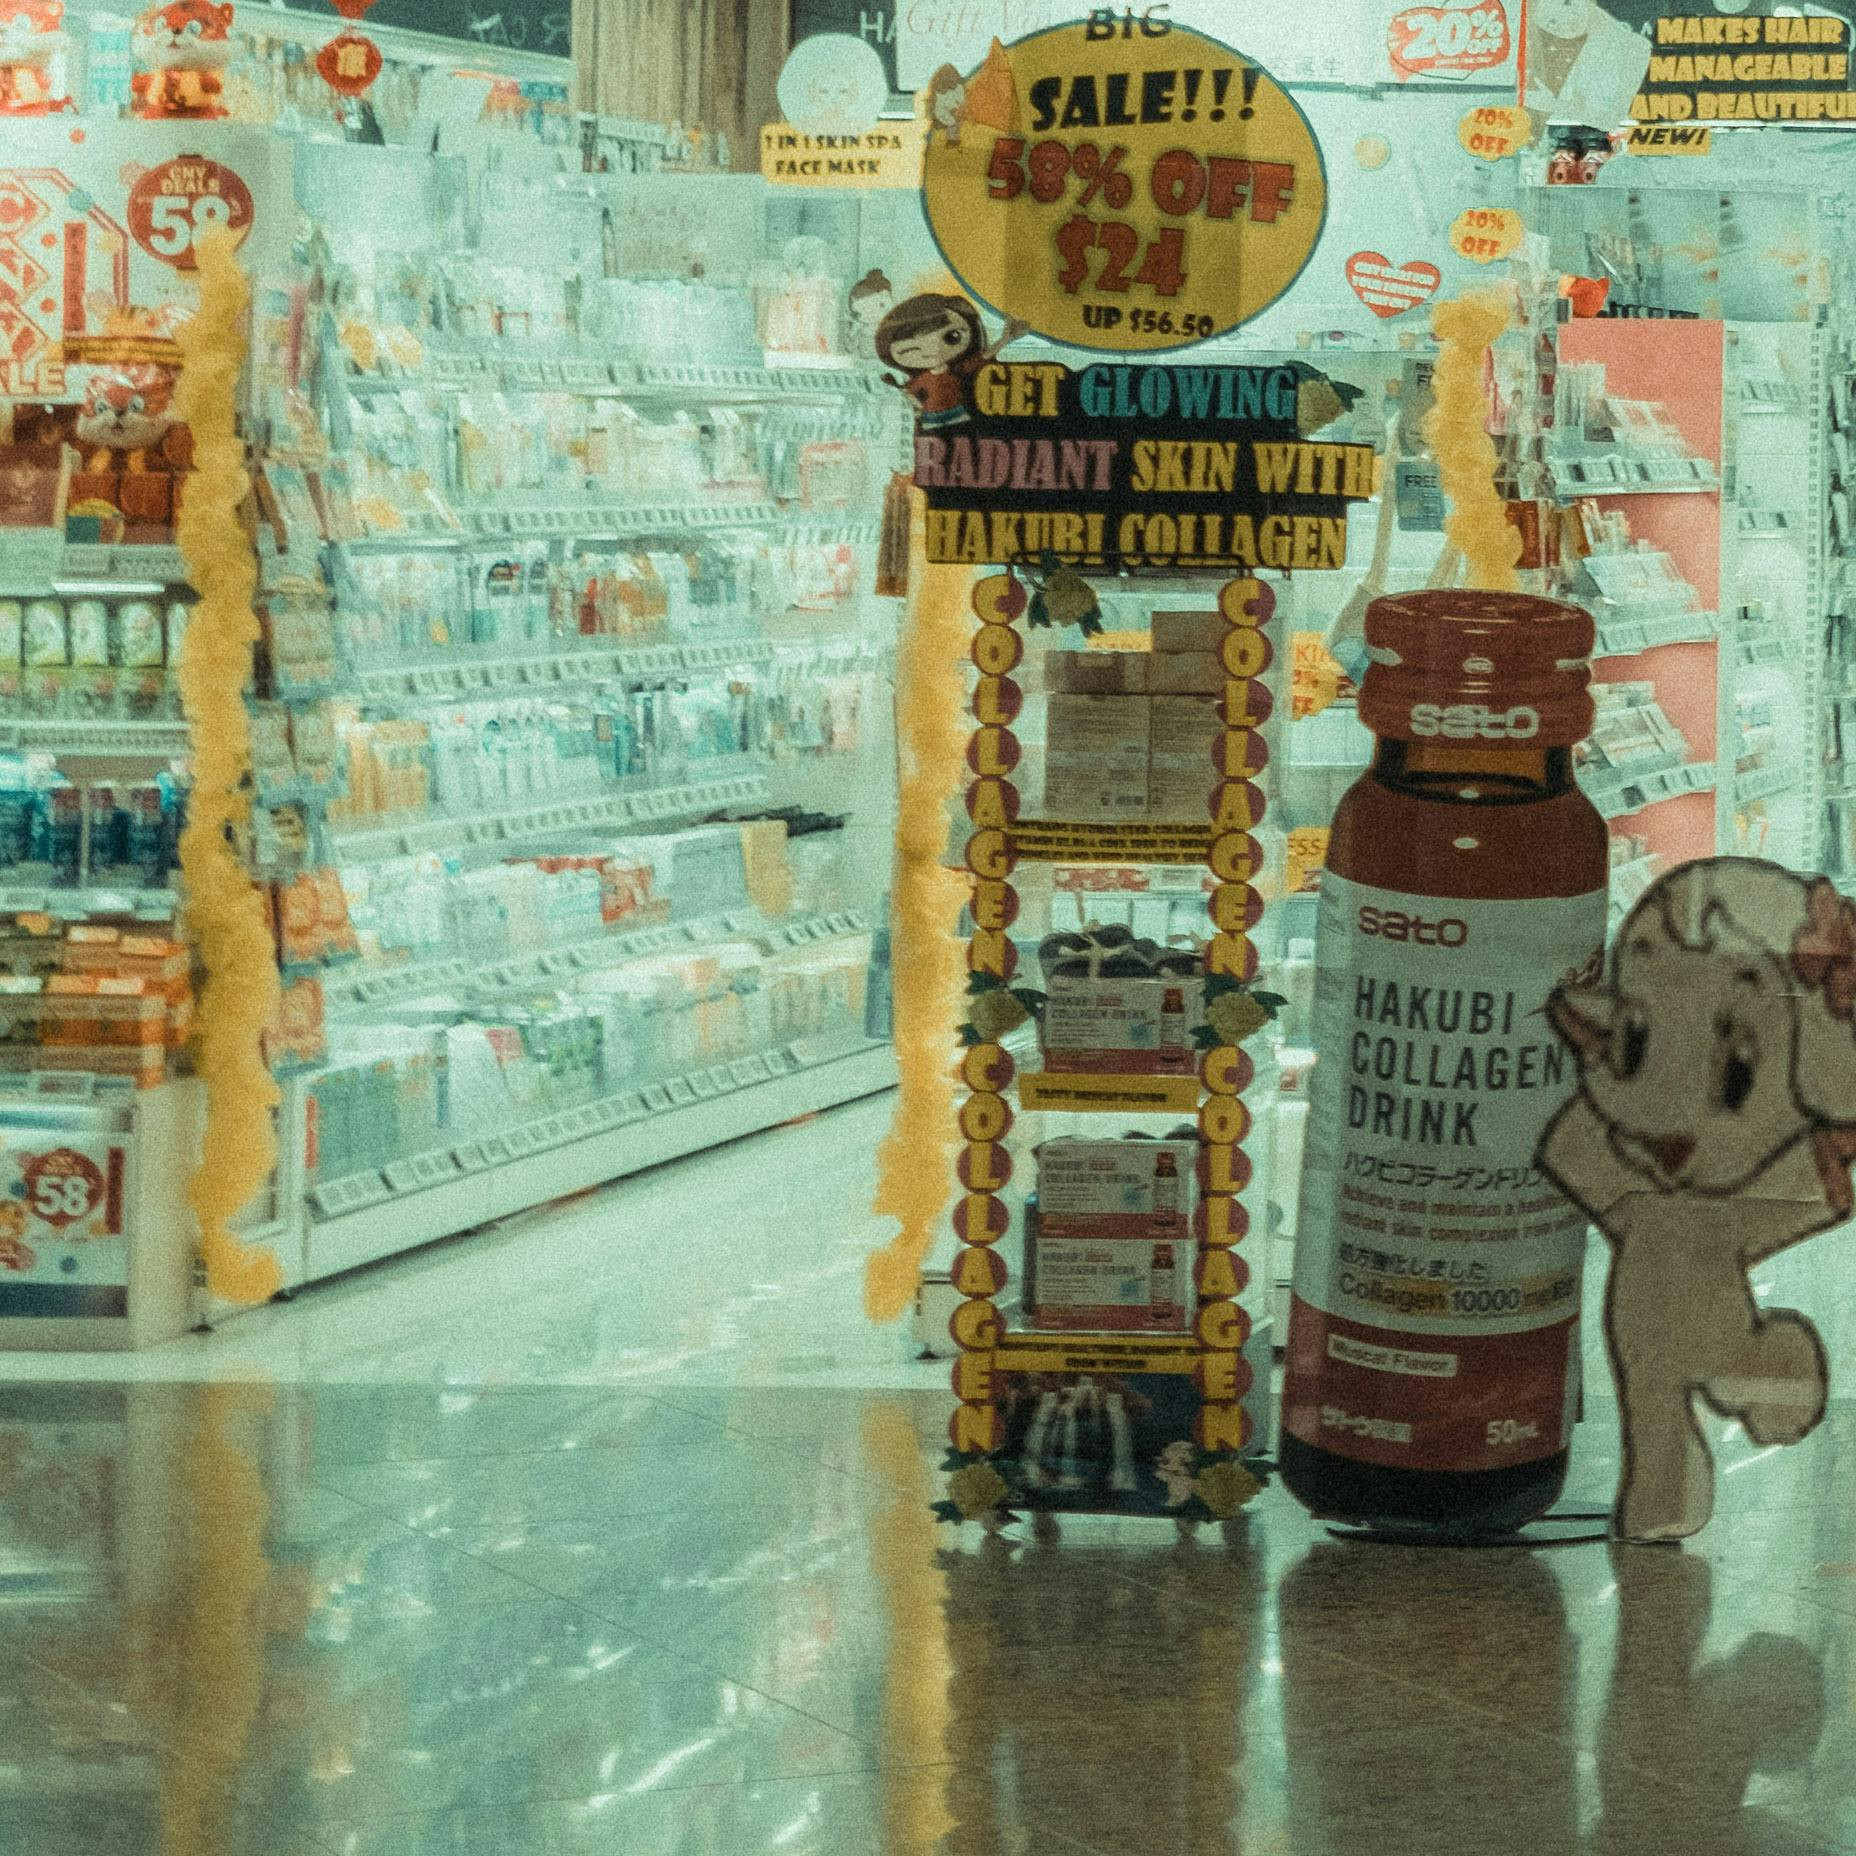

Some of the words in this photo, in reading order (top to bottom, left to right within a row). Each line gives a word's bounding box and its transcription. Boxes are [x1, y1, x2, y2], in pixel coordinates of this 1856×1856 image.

[1085, 3, 1172, 42] BIG
[1657, 15, 1760, 45] MAKES
[1764, 15, 1846, 46] HAIR
[1649, 53, 1848, 83] MANAGEABLE
[1029, 66, 1261, 132] SALE!!!
[1629, 92, 1692, 121] AND
[1470, 133, 1509, 155] OFF
[1628, 127, 1706, 146] NEW!
[987, 136, 1134, 212] 58%
[1150, 148, 1297, 225] OFF
[1056, 213, 1189, 298] $24
[1460, 236, 1500, 257] OFF
[1082, 304, 1123, 330] UP
[1130, 305, 1215, 339] $56.50
[973, 365, 1067, 419] GET
[1079, 365, 1299, 421] GLOWING
[913, 435, 1119, 491] RADIANT
[1131, 439, 1238, 494] SKIN
[1254, 442, 1374, 499] WITH
[927, 506, 1106, 565] HAKUBI
[1117, 512, 1347, 571] COLLAGEN
[1358, 904, 1469, 948] sato
[1354, 974, 1516, 1037] HAKUBI
[1350, 1031, 1565, 1094] COLLAGEN
[1349, 1089, 1480, 1147] DRINK
